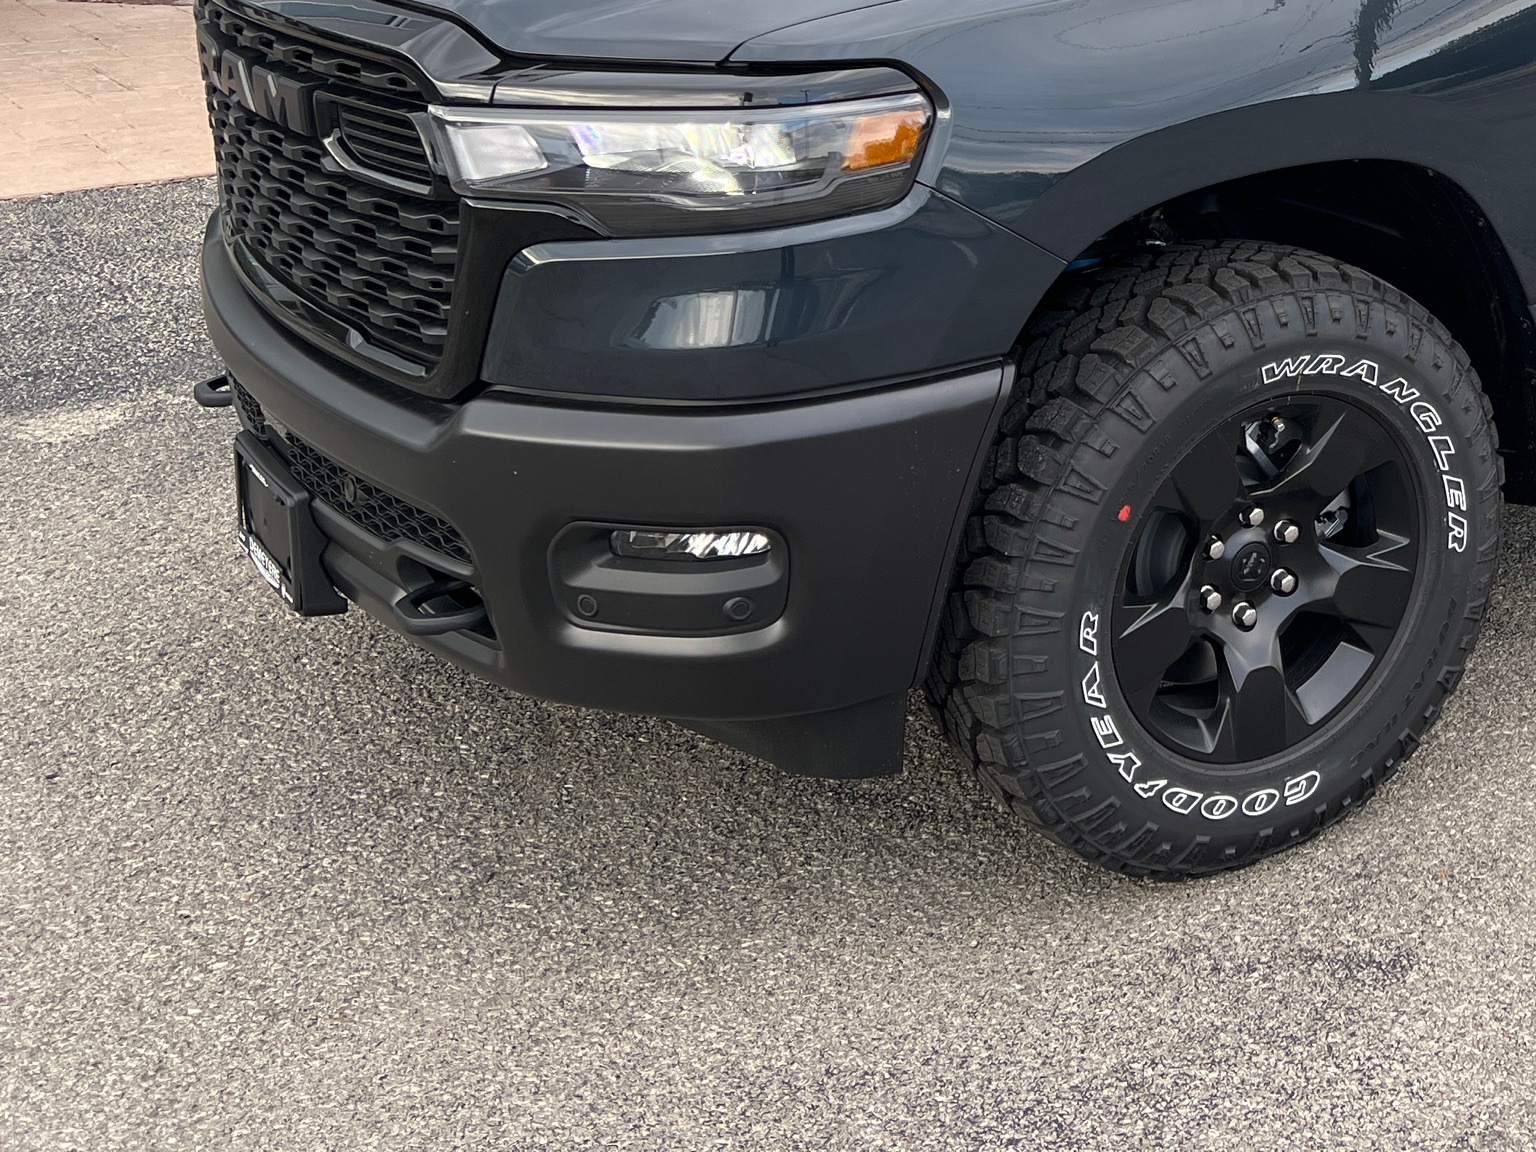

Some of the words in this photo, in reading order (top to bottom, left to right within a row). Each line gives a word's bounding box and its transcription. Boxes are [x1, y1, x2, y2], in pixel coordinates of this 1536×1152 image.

[197, 19, 306, 138] RAM
[1261, 353, 1469, 554] WRANGLER
[1078, 609, 1322, 820] GOODYEAR
